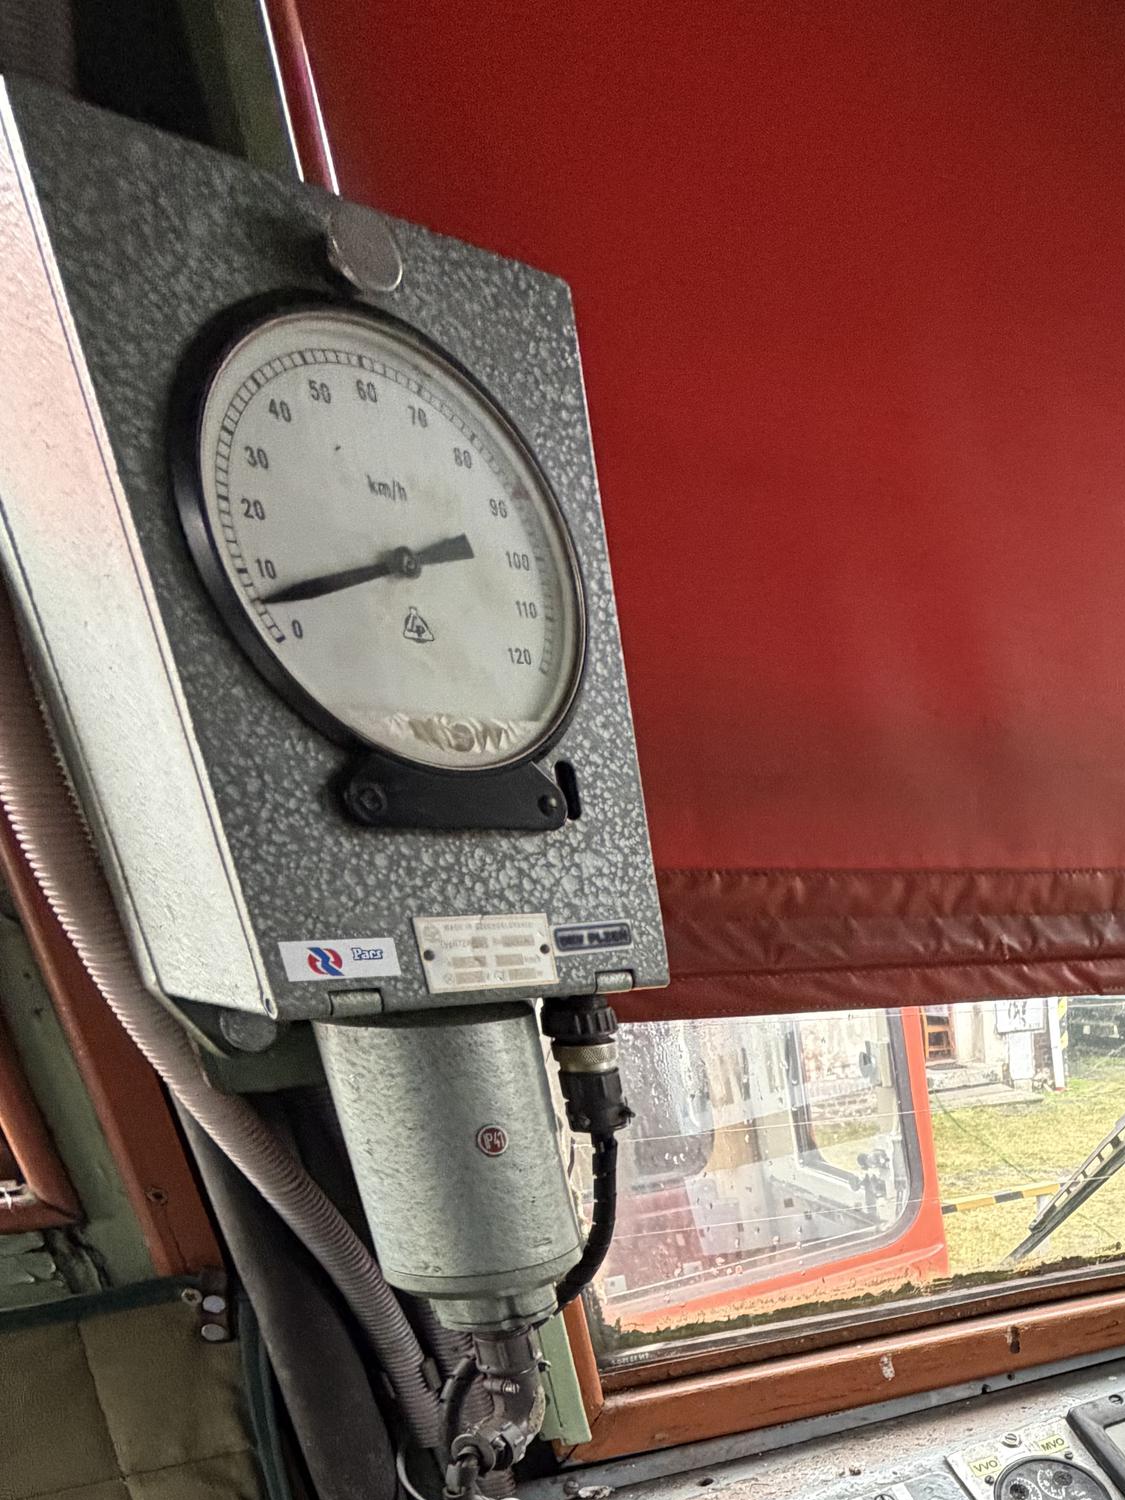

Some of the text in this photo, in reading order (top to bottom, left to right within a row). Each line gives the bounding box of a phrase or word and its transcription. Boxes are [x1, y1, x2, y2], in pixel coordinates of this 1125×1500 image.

[309, 380, 331, 403] 50
[356, 380, 377, 403] 60
[268, 400, 291, 422] 40
[408, 406, 427, 427] 70
[245, 447, 268, 469] 30
[454, 448, 471, 468] 80
[367, 475, 407, 501] km/h
[241, 500, 265, 520] 20
[489, 500, 507, 518] 90
[256, 560, 276, 580] 10
[505, 552, 529, 571] 100
[516, 601, 537, 619] 110
[293, 620, 303, 638] 0
[508, 648, 531, 665] 120
[1042, 1438, 1065, 1451] MVO
[973, 1459, 998, 1472] VVO
